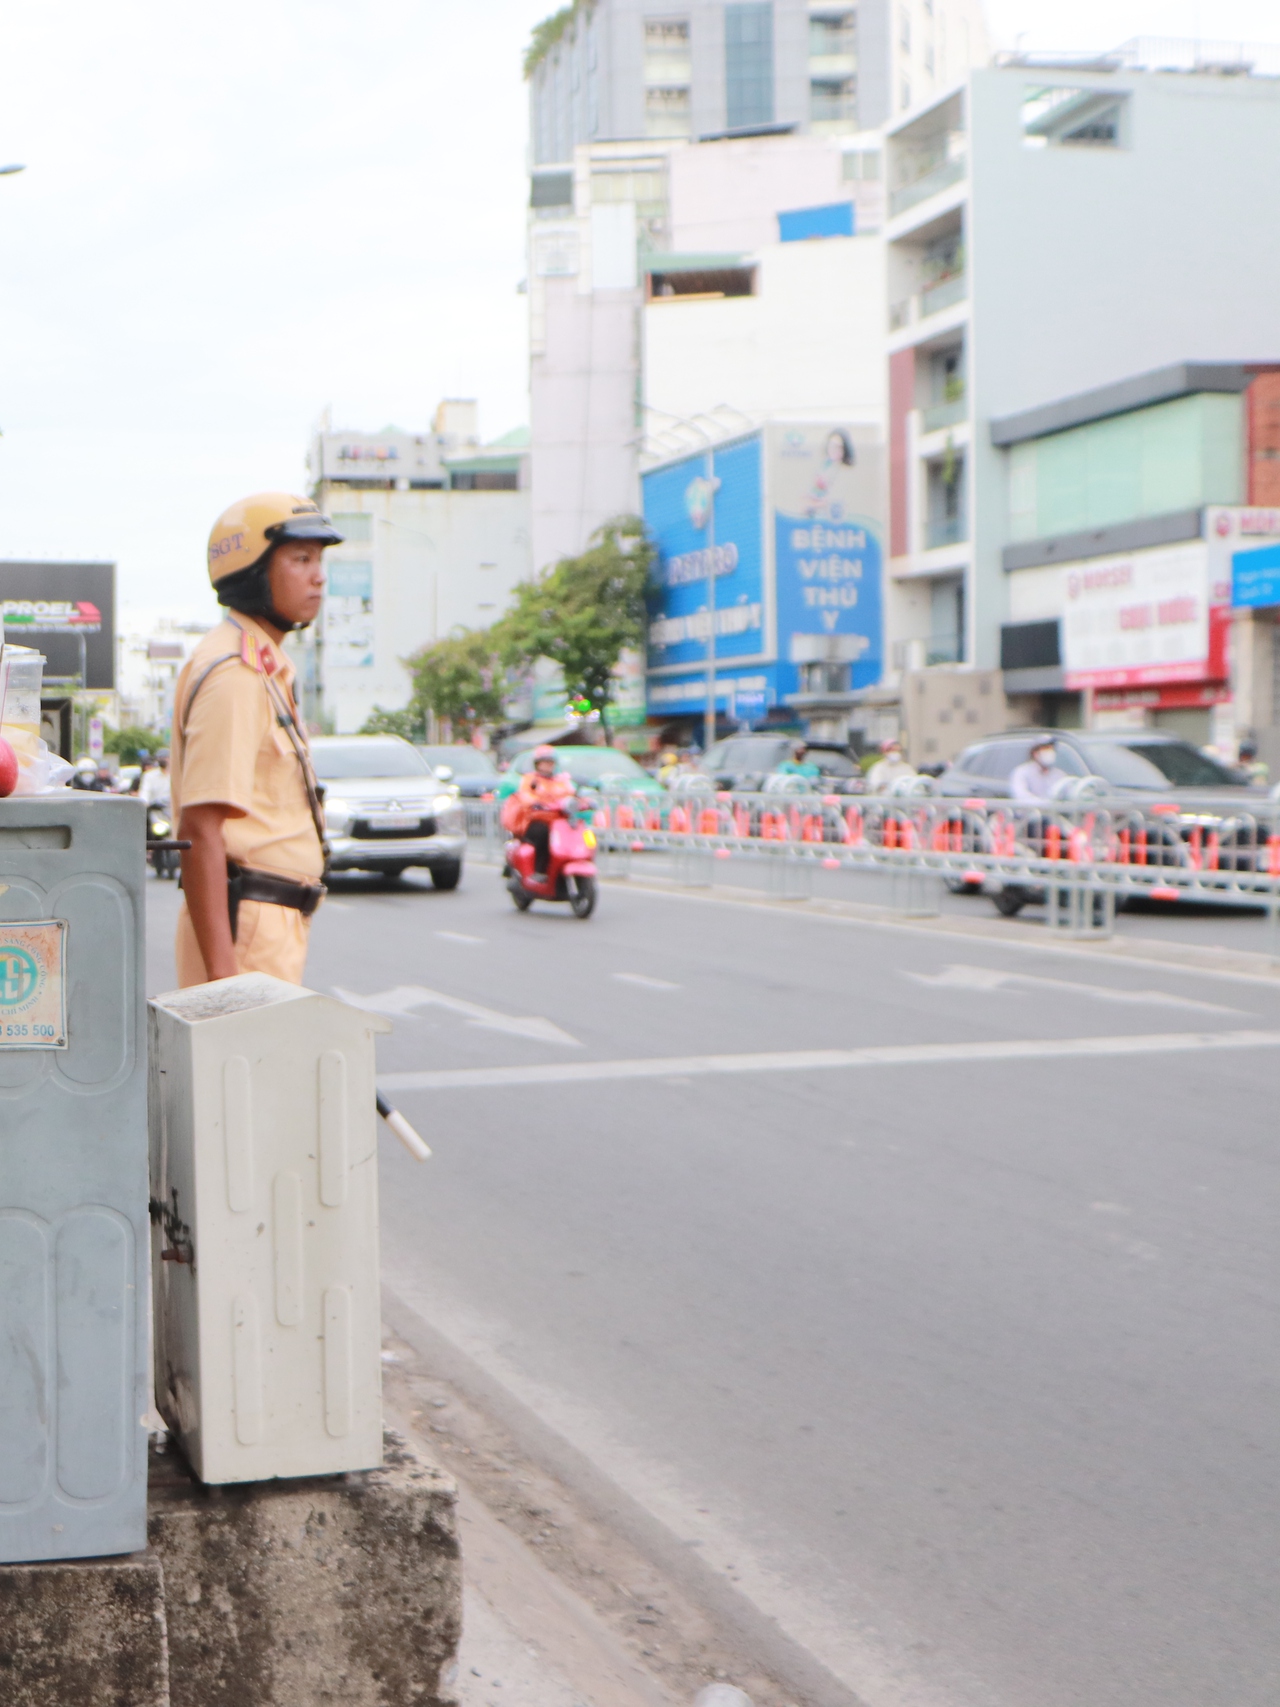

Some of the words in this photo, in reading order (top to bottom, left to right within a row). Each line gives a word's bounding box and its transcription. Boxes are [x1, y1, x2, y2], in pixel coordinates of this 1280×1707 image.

[791, 524, 866, 551] BỆNH
[797, 554, 863, 582] VIỆN
[803, 582, 857, 606] THÚ
[823, 611, 840, 631] Y
[6, 1024, 29, 1037] 535
[32, 1024, 55, 1037] 500
